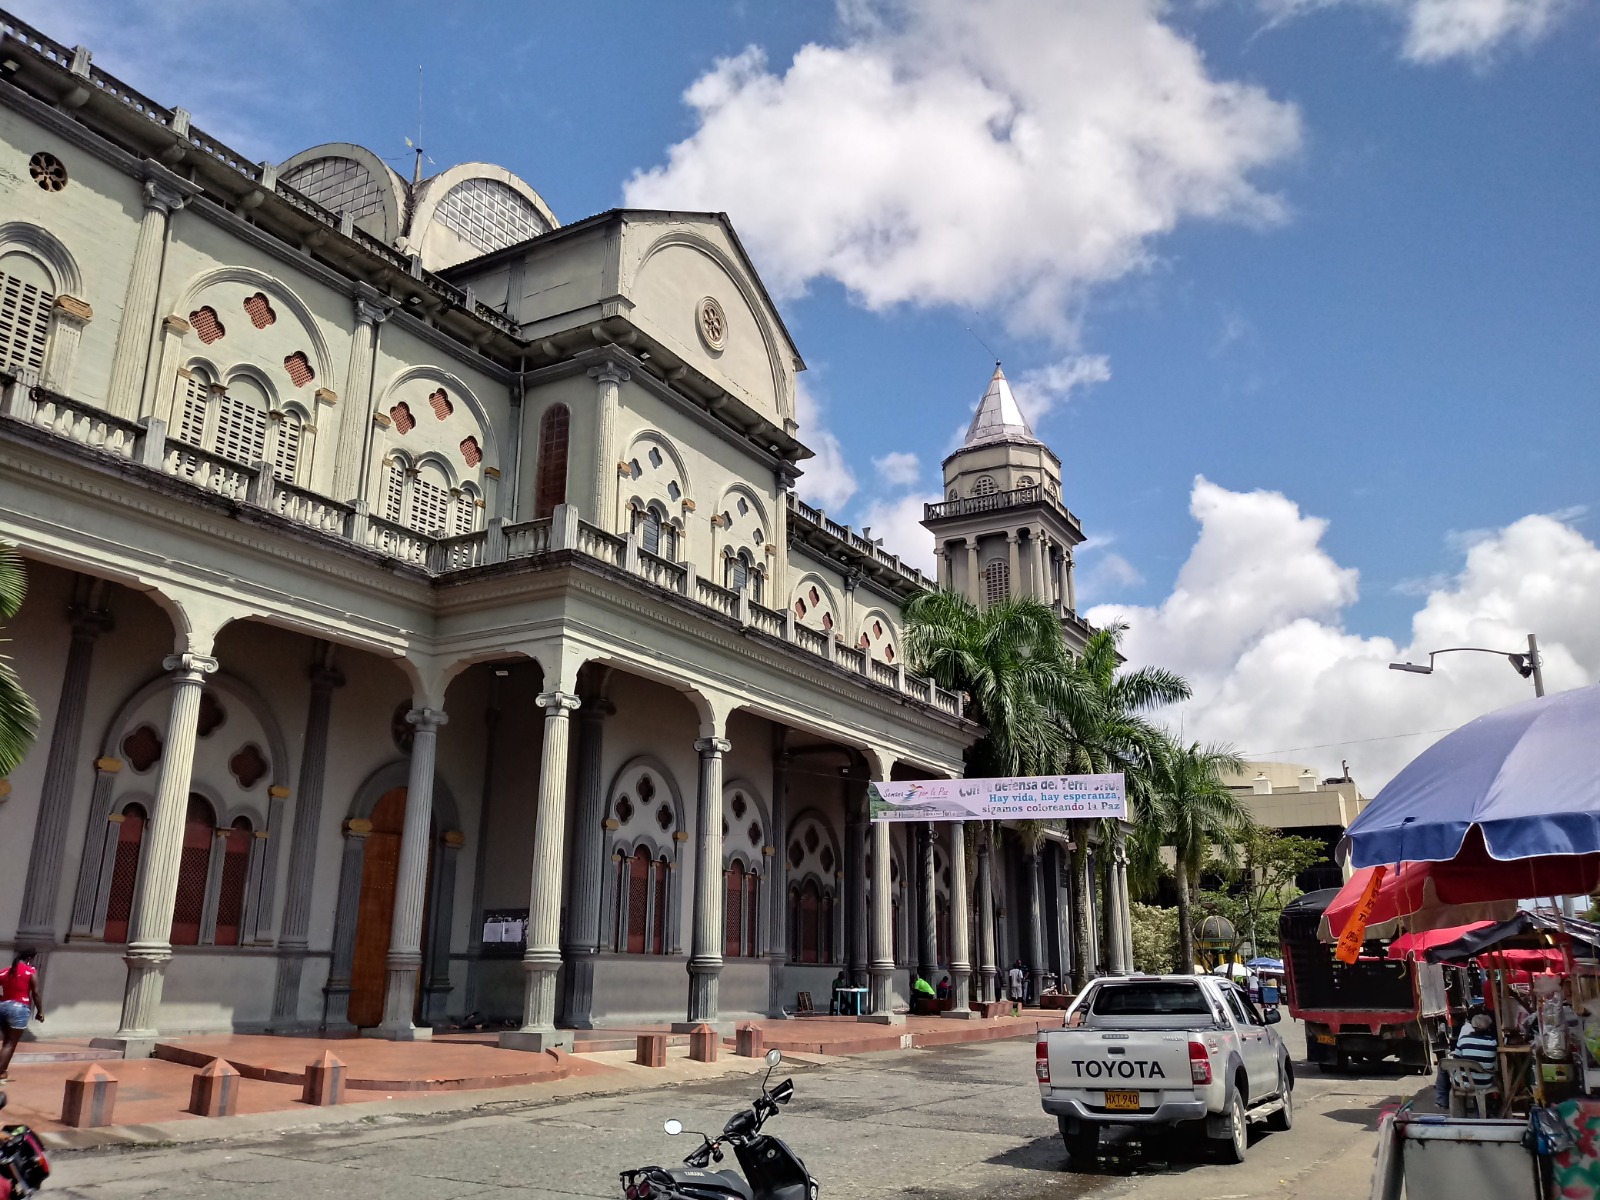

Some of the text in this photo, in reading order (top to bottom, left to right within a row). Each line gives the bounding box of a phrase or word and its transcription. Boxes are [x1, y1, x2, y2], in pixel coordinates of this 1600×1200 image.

[938, 786, 949, 796] Paz
[989, 792, 1121, 804] Hay vida, hay esperanza,
[982, 801, 1121, 815] sigamos coloreando la Paz
[1071, 1060, 1166, 1078] TOYOTA
